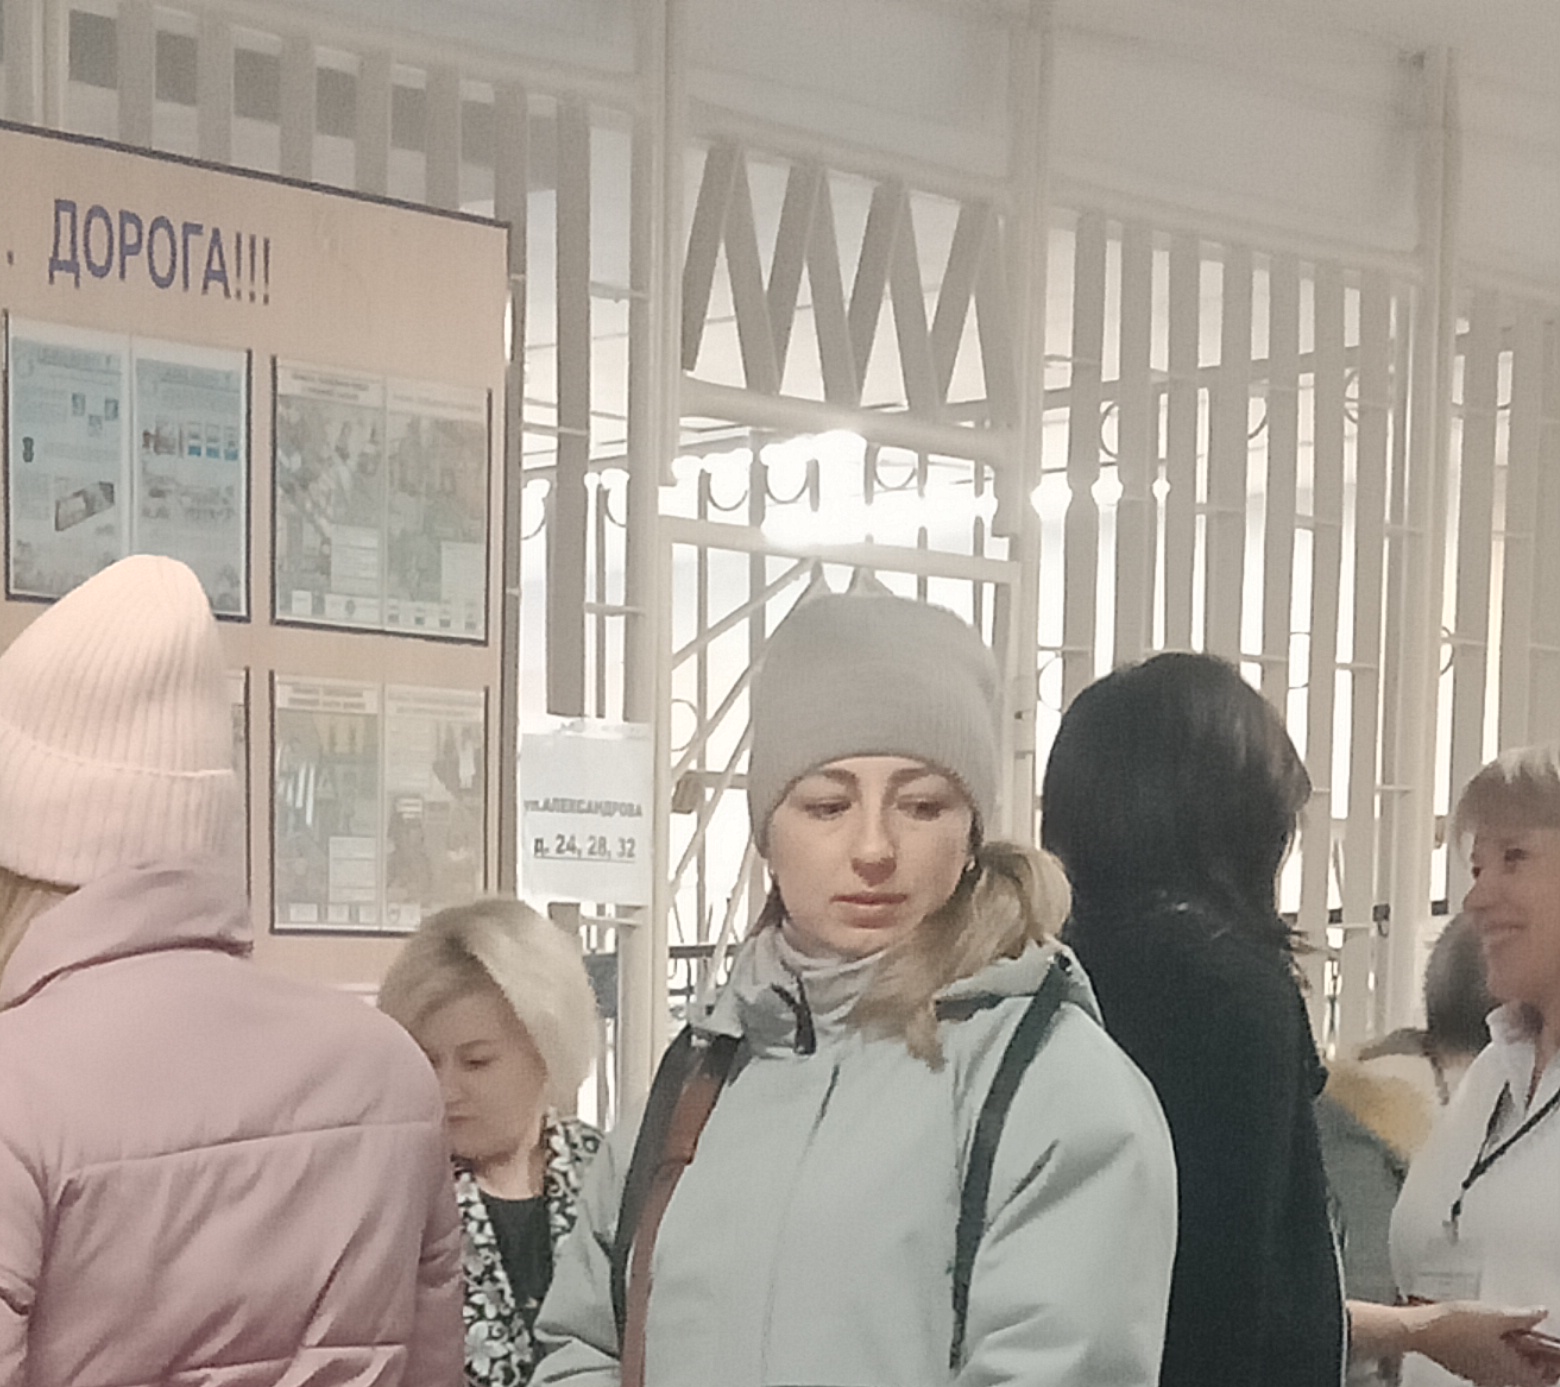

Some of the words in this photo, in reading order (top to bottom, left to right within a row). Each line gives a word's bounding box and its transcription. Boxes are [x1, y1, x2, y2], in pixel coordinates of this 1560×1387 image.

[48, 198, 271, 306] ДОРОГА!!!
[555, 833, 583, 860] 24,
[587, 834, 612, 860] 28,
[616, 836, 636, 858] 32
